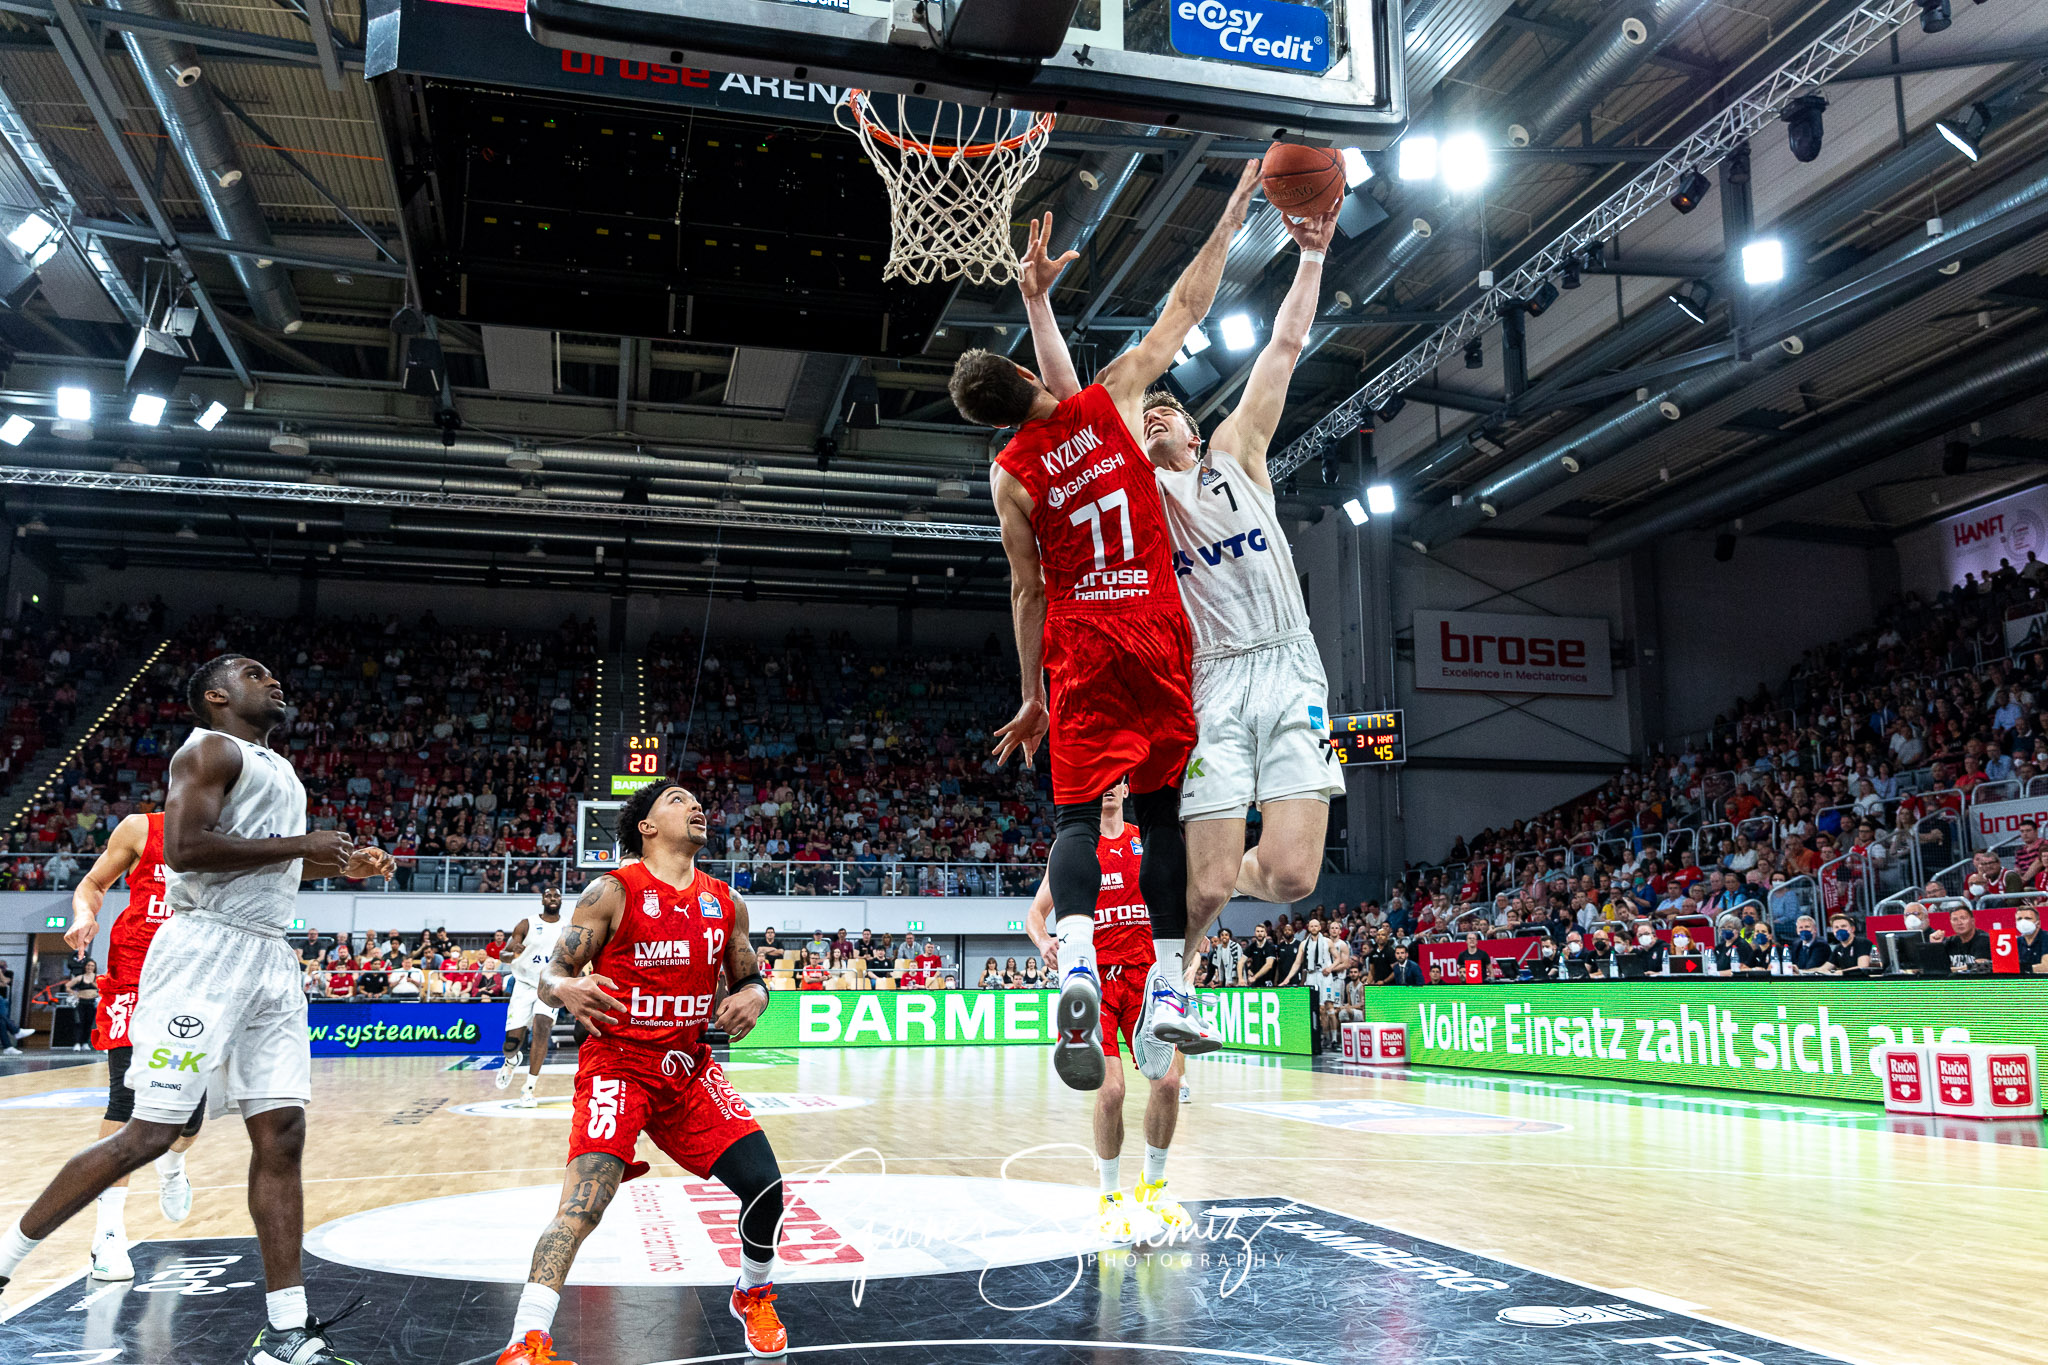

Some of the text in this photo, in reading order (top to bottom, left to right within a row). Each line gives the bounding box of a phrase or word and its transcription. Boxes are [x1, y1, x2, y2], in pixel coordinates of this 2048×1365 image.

[1040, 424, 1103, 475] KYZLINK
[1211, 481, 1238, 512] 7
[1069, 487, 1135, 570] 77
[1199, 528, 1268, 566] VTG
[1440, 621, 1586, 668] brose
[1442, 667, 1588, 682] Excellence in Mechatronics
[1357, 734, 1365, 748] 3
[1377, 735, 1393, 745] HAM
[1374, 745, 1394, 760] 45
[629, 753, 657, 773] 20
[634, 941, 673, 959] LVM
[703, 927, 725, 965] 12
[1996, 934, 2012, 956] 5
[634, 959, 690, 967] VERSICHERUNG
[1468, 963, 1478, 978] 5
[630, 1017, 674, 1027] Excellence
[676, 1019, 684, 1027] in
[799, 993, 1058, 1042] BARME
[1382, 1031, 1402, 1041] RHÖN
[1418, 1001, 1497, 1053] Voller
[1504, 1002, 1627, 1060] Einsatz
[1635, 1003, 1742, 1068] zahlt
[1752, 1005, 1853, 1075] sich
[148, 1048, 207, 1073] S+K
[1890, 1058, 1916, 1074] RHÖN
[1940, 1060, 1968, 1076] RHÖN
[1992, 1061, 2026, 1076] RHÖN
[150, 1080, 182, 1091] SPALDING
[1891, 1074, 1918, 1083] SPRUDEL
[1941, 1076, 1969, 1086] SPRUDEL
[1993, 1077, 2027, 1086] SPRUDEL
[698, 1077, 732, 1121] AUTOMATION
[1265, 1219, 1510, 1292] BAMBERG
